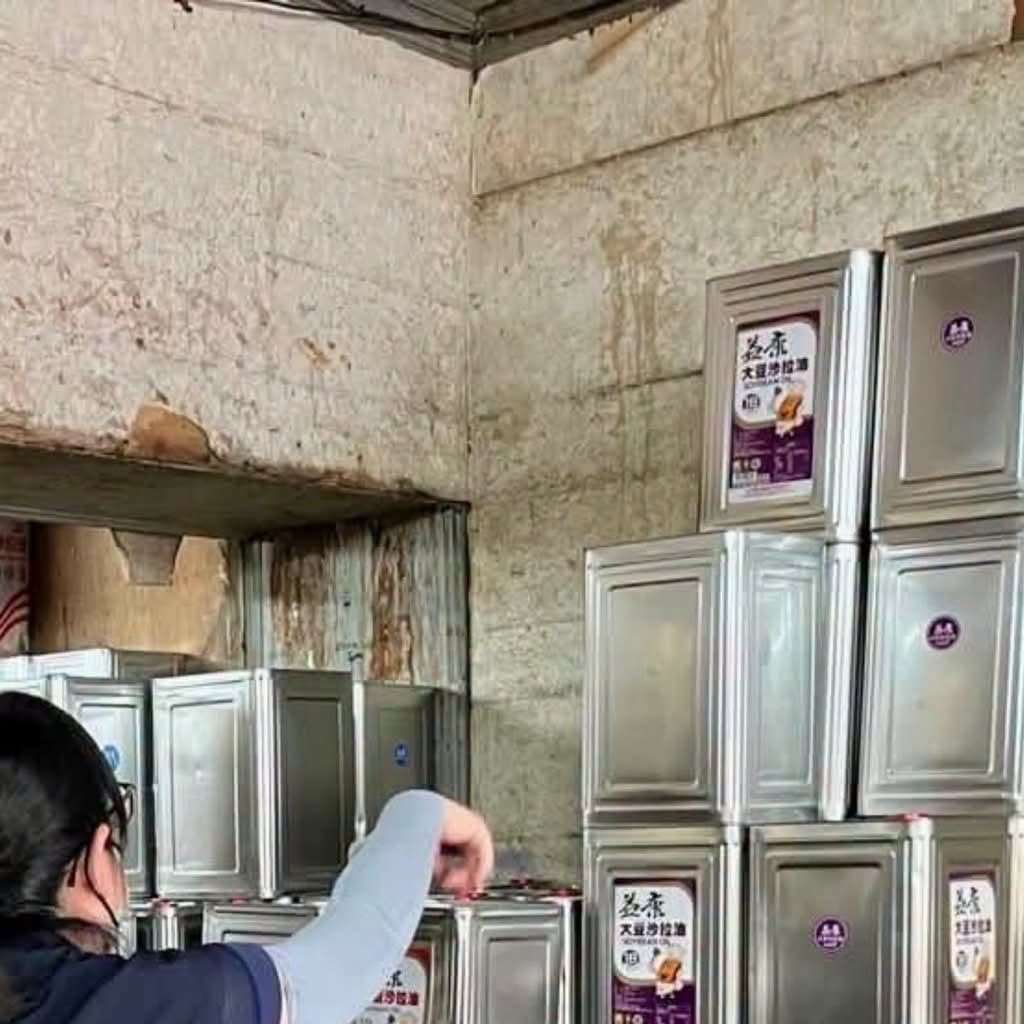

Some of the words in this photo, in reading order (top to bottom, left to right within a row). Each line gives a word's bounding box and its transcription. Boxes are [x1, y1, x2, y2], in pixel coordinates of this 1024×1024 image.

[742, 358, 809, 381] 大豆沙拉油
[619, 921, 687, 937] 大豆沙拉油
